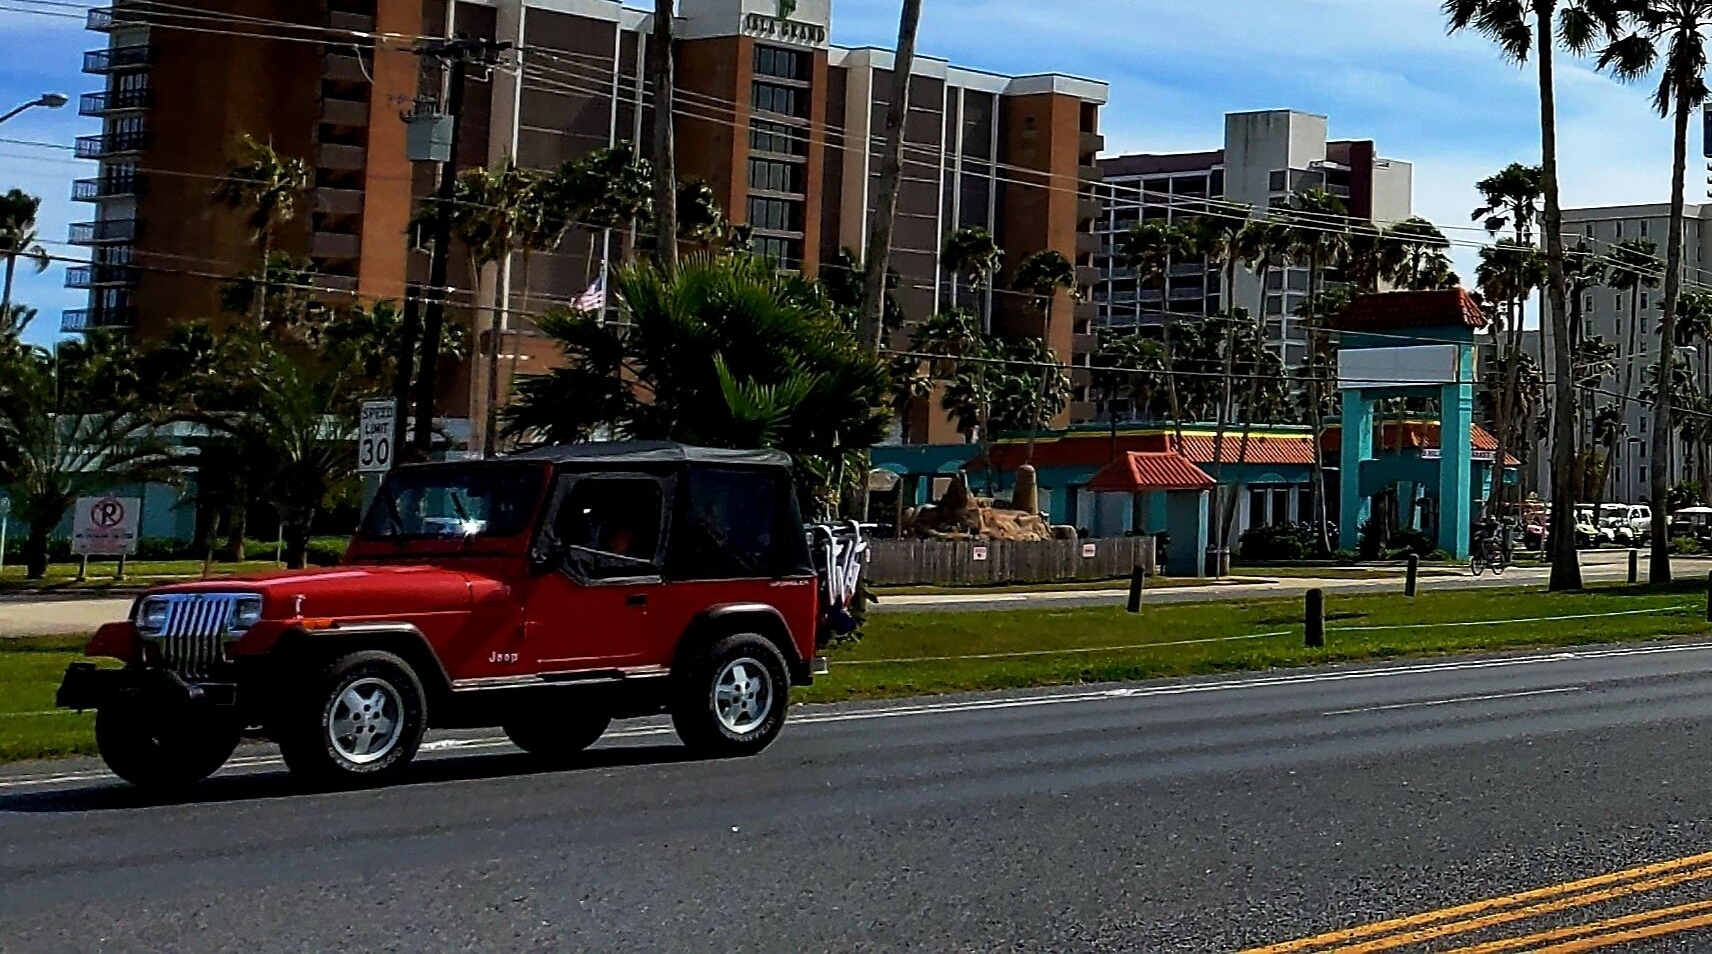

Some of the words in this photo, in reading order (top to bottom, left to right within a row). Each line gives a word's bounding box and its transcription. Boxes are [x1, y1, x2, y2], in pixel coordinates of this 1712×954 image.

[745, 14, 776, 34] ISLA
[781, 20, 825, 43] GRAND
[361, 437, 389, 466] 30
[488, 650, 519, 664] Jeep
